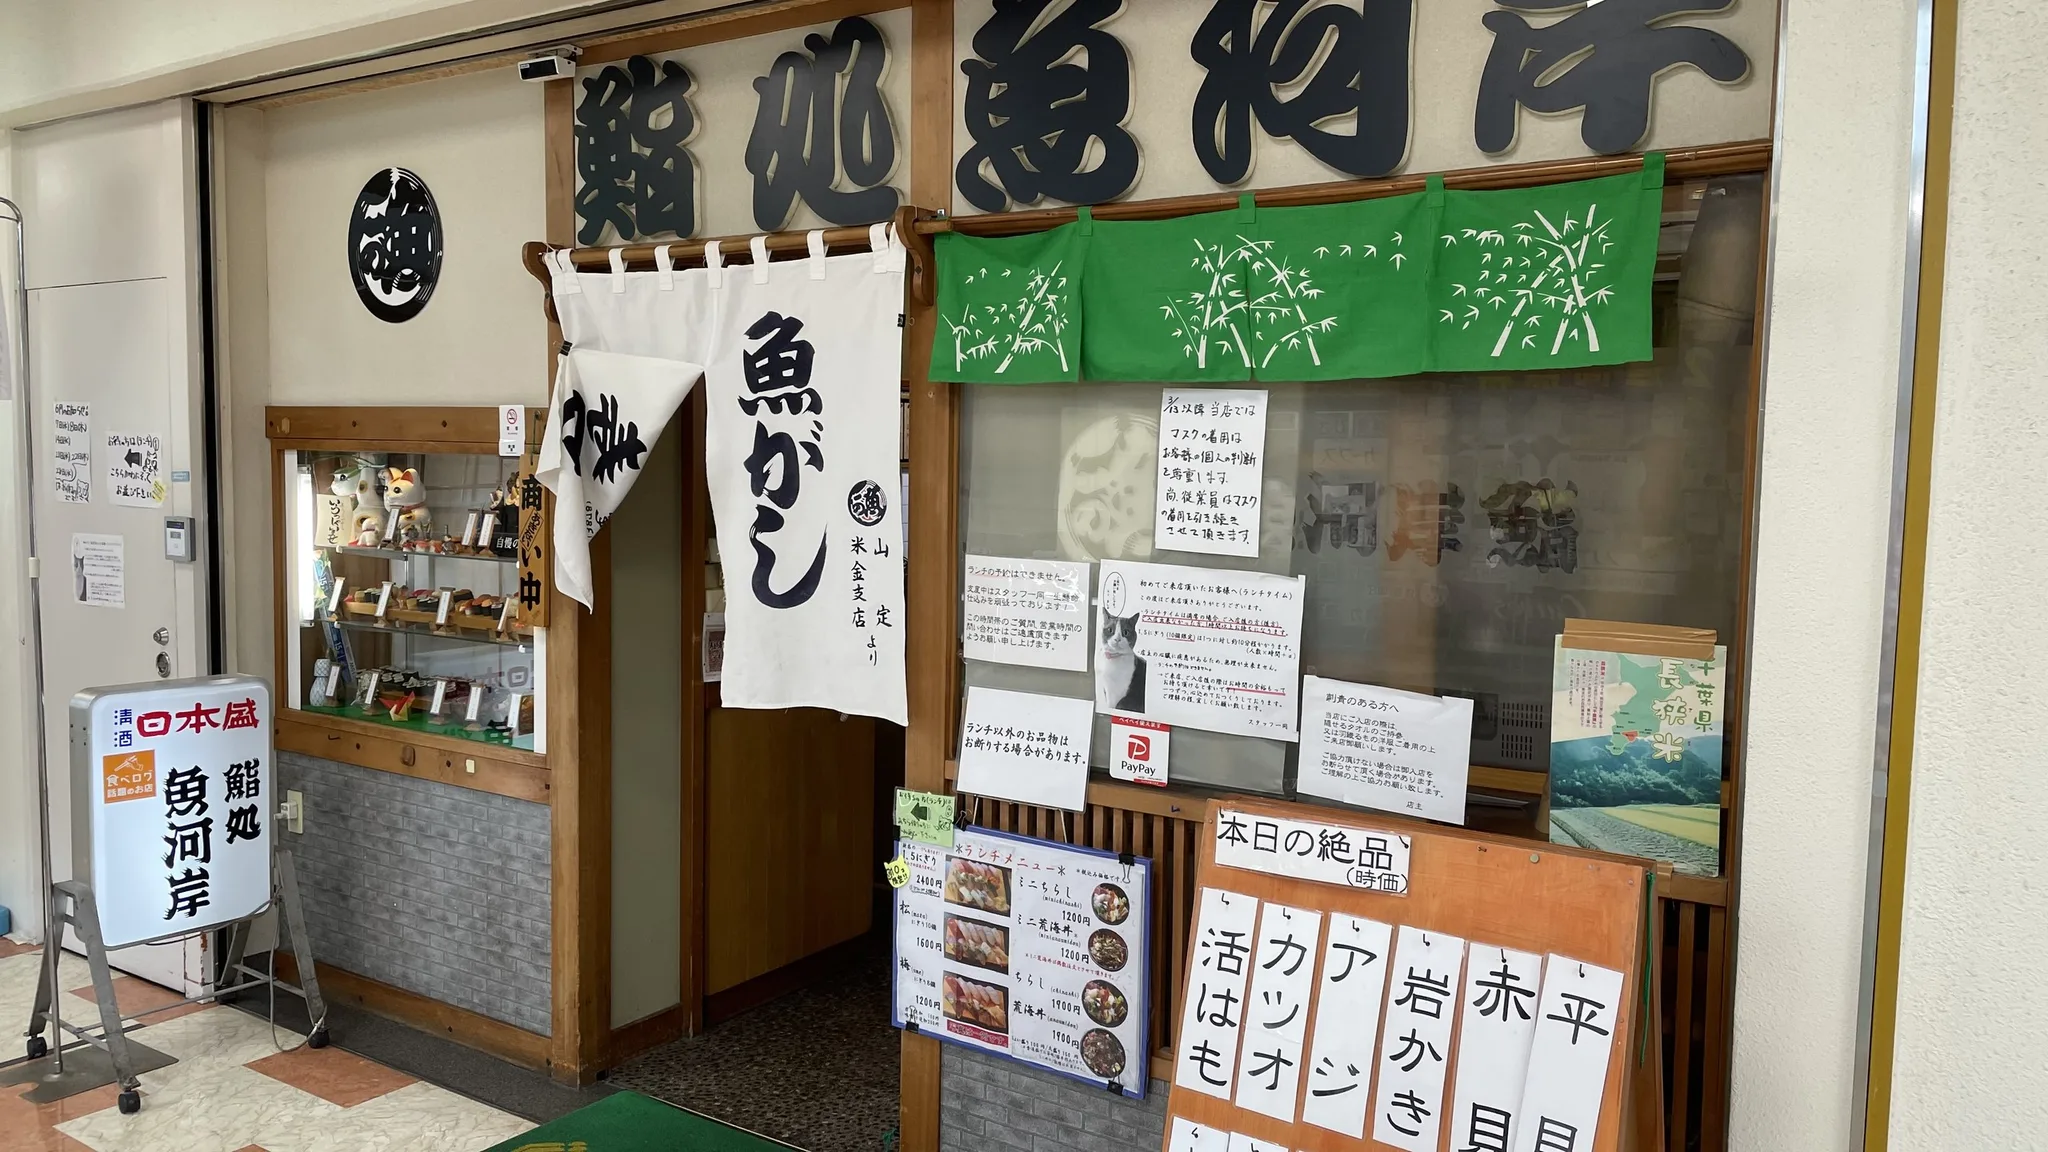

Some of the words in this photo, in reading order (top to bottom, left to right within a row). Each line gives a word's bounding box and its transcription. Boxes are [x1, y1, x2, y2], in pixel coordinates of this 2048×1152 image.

[738, 310, 827, 610] 魚がし
[850, 535, 867, 628] 米金支店
[114, 708, 133, 748] 清酒
[136, 697, 260, 738] 日本盛
[966, 722, 1069, 746] ランチ以外のお品物は
[1121, 760, 1156, 776] PayPay
[222, 757, 262, 845] 鮨処
[161, 765, 214, 922] 魚河岸
[1217, 813, 1394, 871] 本日の絶品
[916, 874, 943, 889] 2400円
[1346, 866, 1409, 894] (時価)
[1062, 910, 1091, 927] 1200円
[917, 937, 942, 952] 1600円
[1060, 947, 1090, 964] 1200円
[916, 994, 941, 1011] 1200円
[1051, 998, 1081, 1016] 1900円
[1188, 926, 1250, 1087] 活はも
[1247, 933, 1308, 1091] カツオ
[1312, 941, 1378, 1098] アジ
[1052, 1029, 1080, 1050] 1900円
[1387, 966, 1452, 1137] 岩かき
